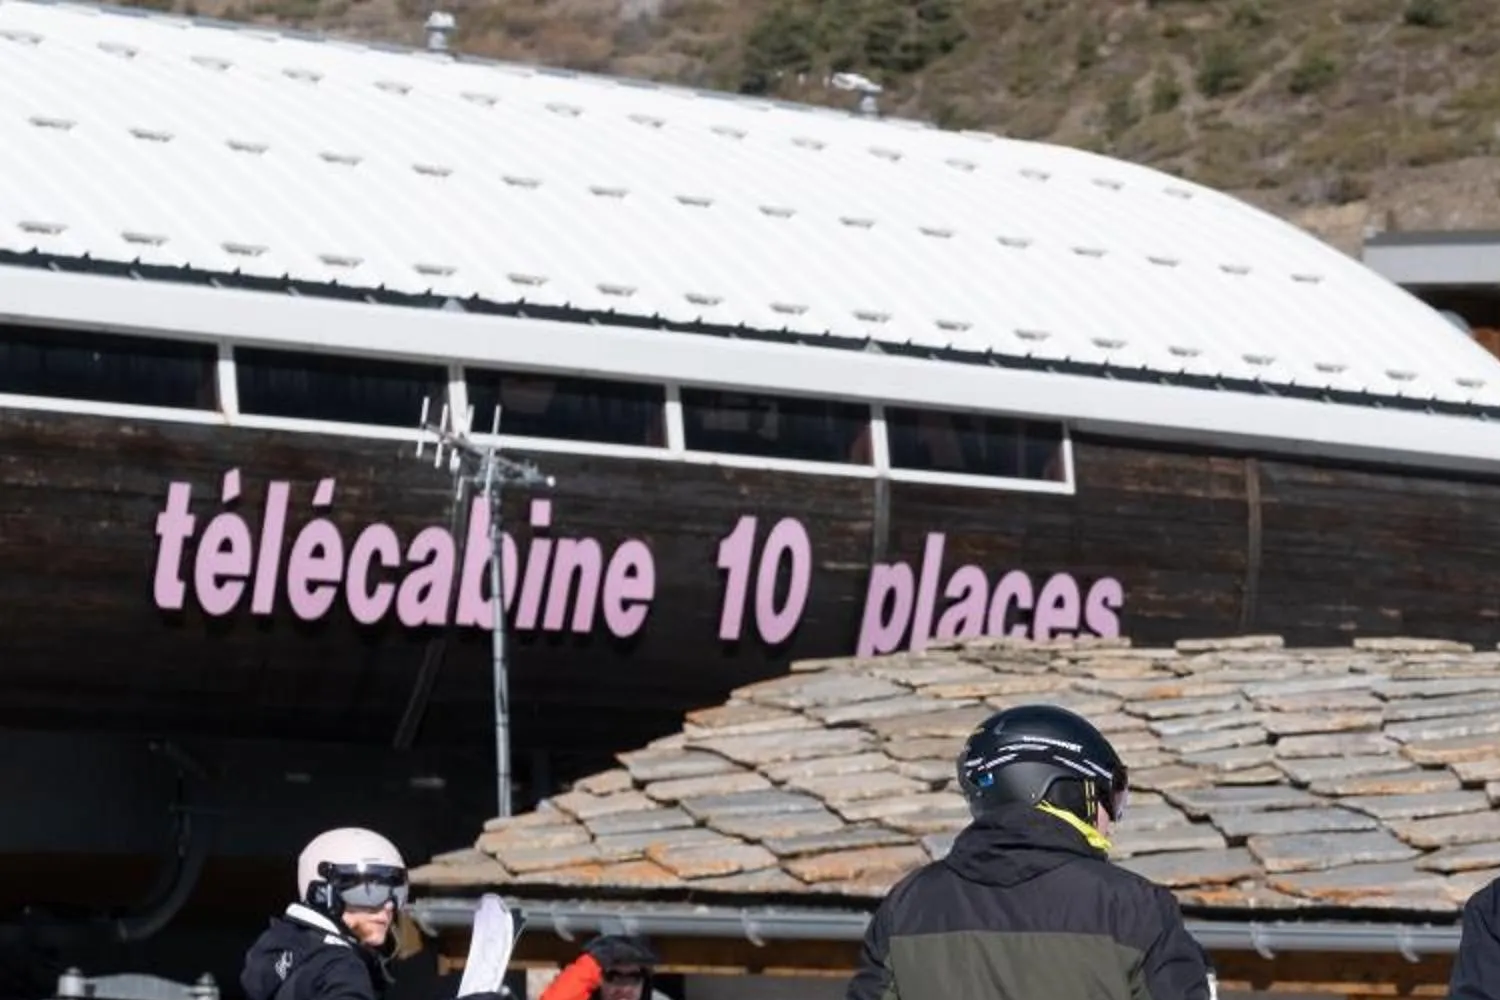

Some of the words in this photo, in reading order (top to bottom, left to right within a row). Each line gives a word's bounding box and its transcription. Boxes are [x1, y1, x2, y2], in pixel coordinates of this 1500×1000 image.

[154, 469, 655, 638] télécabine
[717, 515, 812, 644] 10
[858, 532, 1124, 657] places
